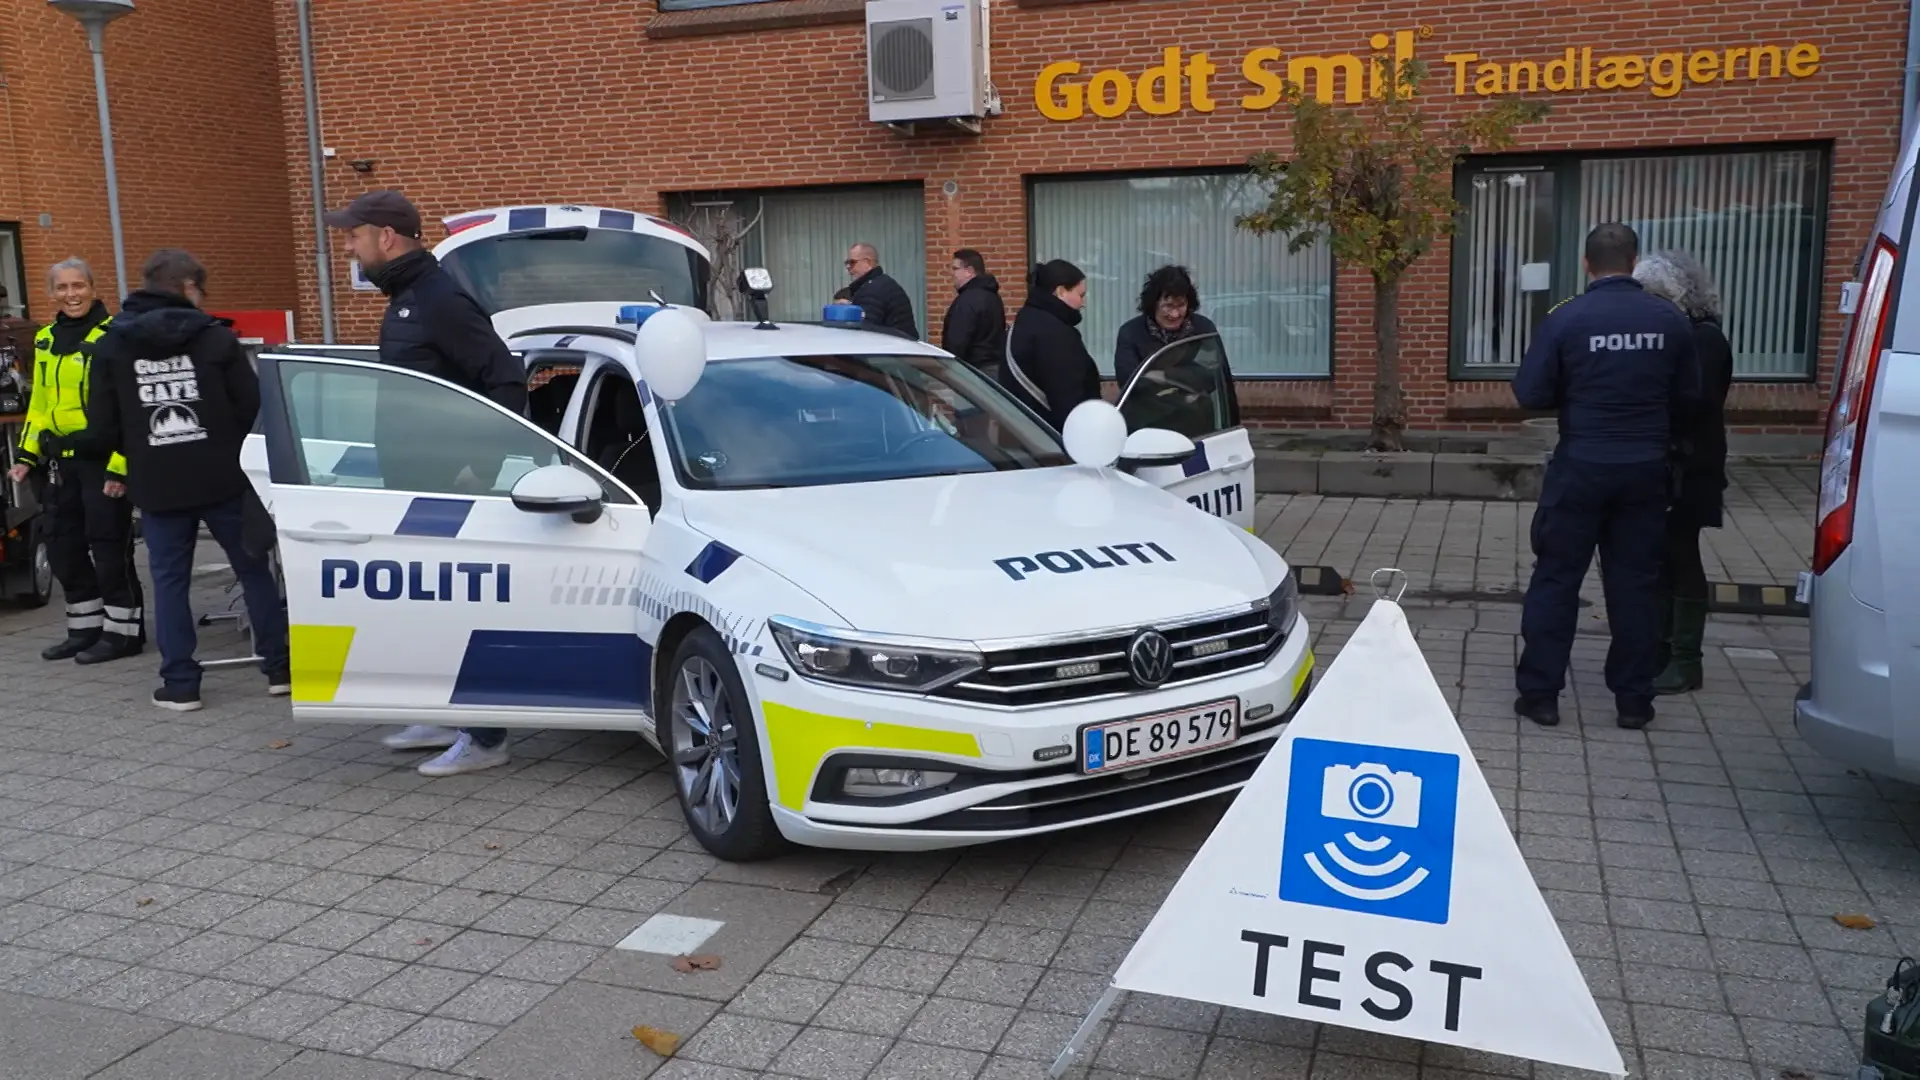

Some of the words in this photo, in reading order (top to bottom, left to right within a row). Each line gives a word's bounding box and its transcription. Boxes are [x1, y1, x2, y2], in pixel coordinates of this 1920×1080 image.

[1034, 46, 1217, 121] Godt
[1444, 43, 1820, 97] Tandlægerne
[1589, 333, 1664, 352] POLITI
[321, 559, 511, 603] POLITI
[994, 542, 1176, 581] POLITI
[1105, 727, 1141, 762] DE
[1149, 719, 1181, 753] 89
[1187, 707, 1233, 744] 579
[1088, 752, 1101, 764] DK
[1240, 929, 1483, 1032] TEST
